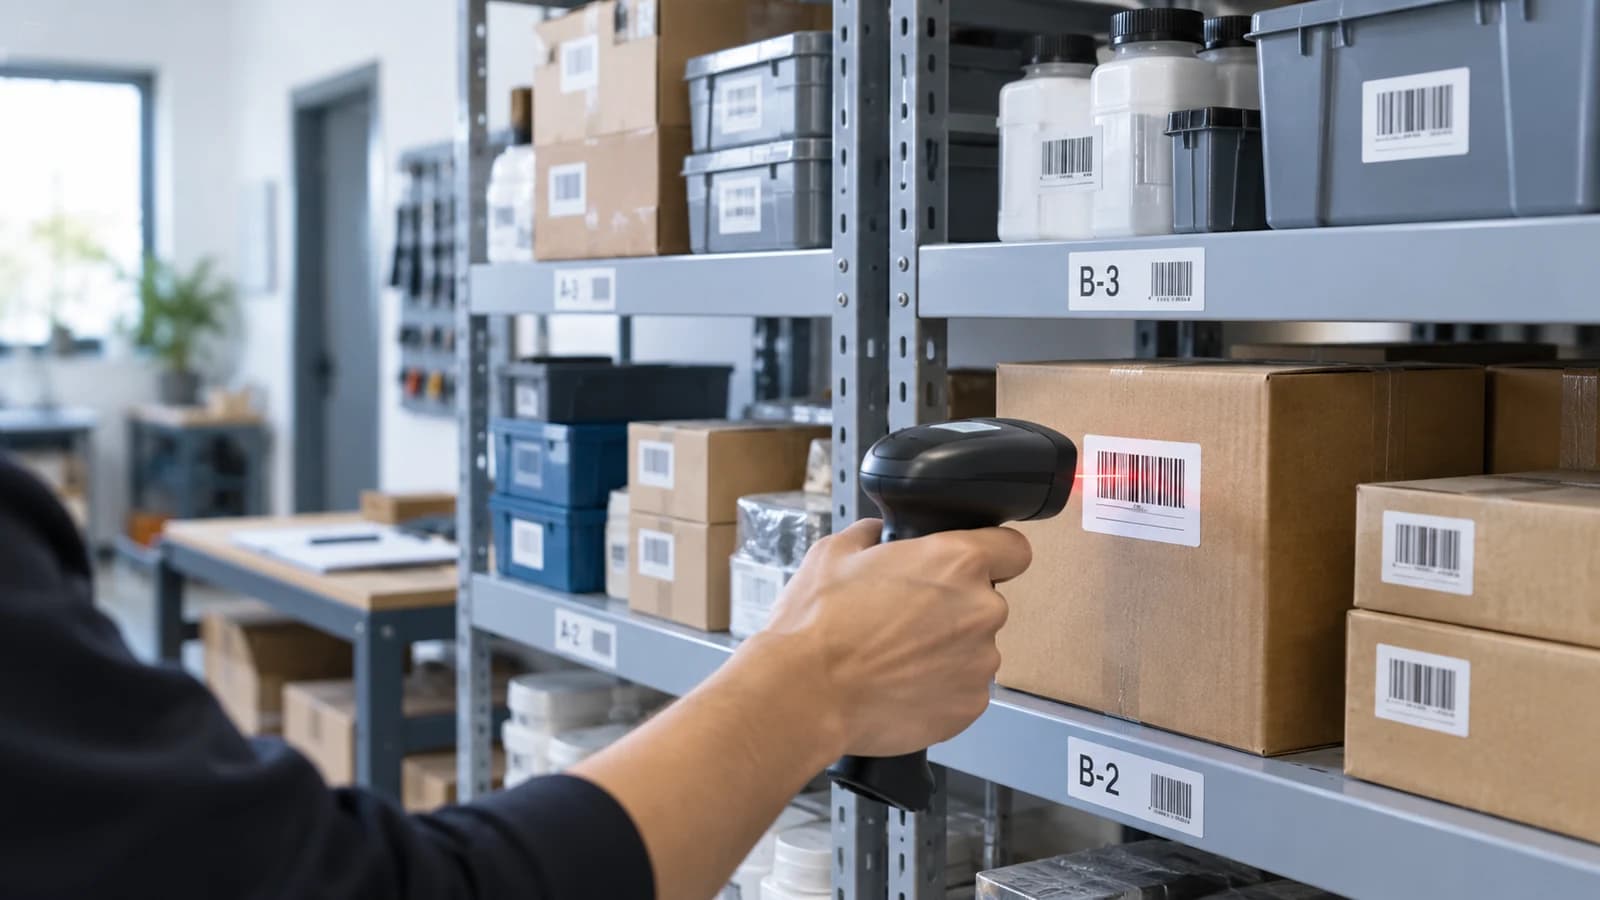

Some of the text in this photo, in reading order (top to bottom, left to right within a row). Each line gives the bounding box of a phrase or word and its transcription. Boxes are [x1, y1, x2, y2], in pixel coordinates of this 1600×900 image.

[1080, 265, 1119, 297] B-3
[560, 619, 580, 646] A-2
[1080, 753, 1120, 796] B-2
